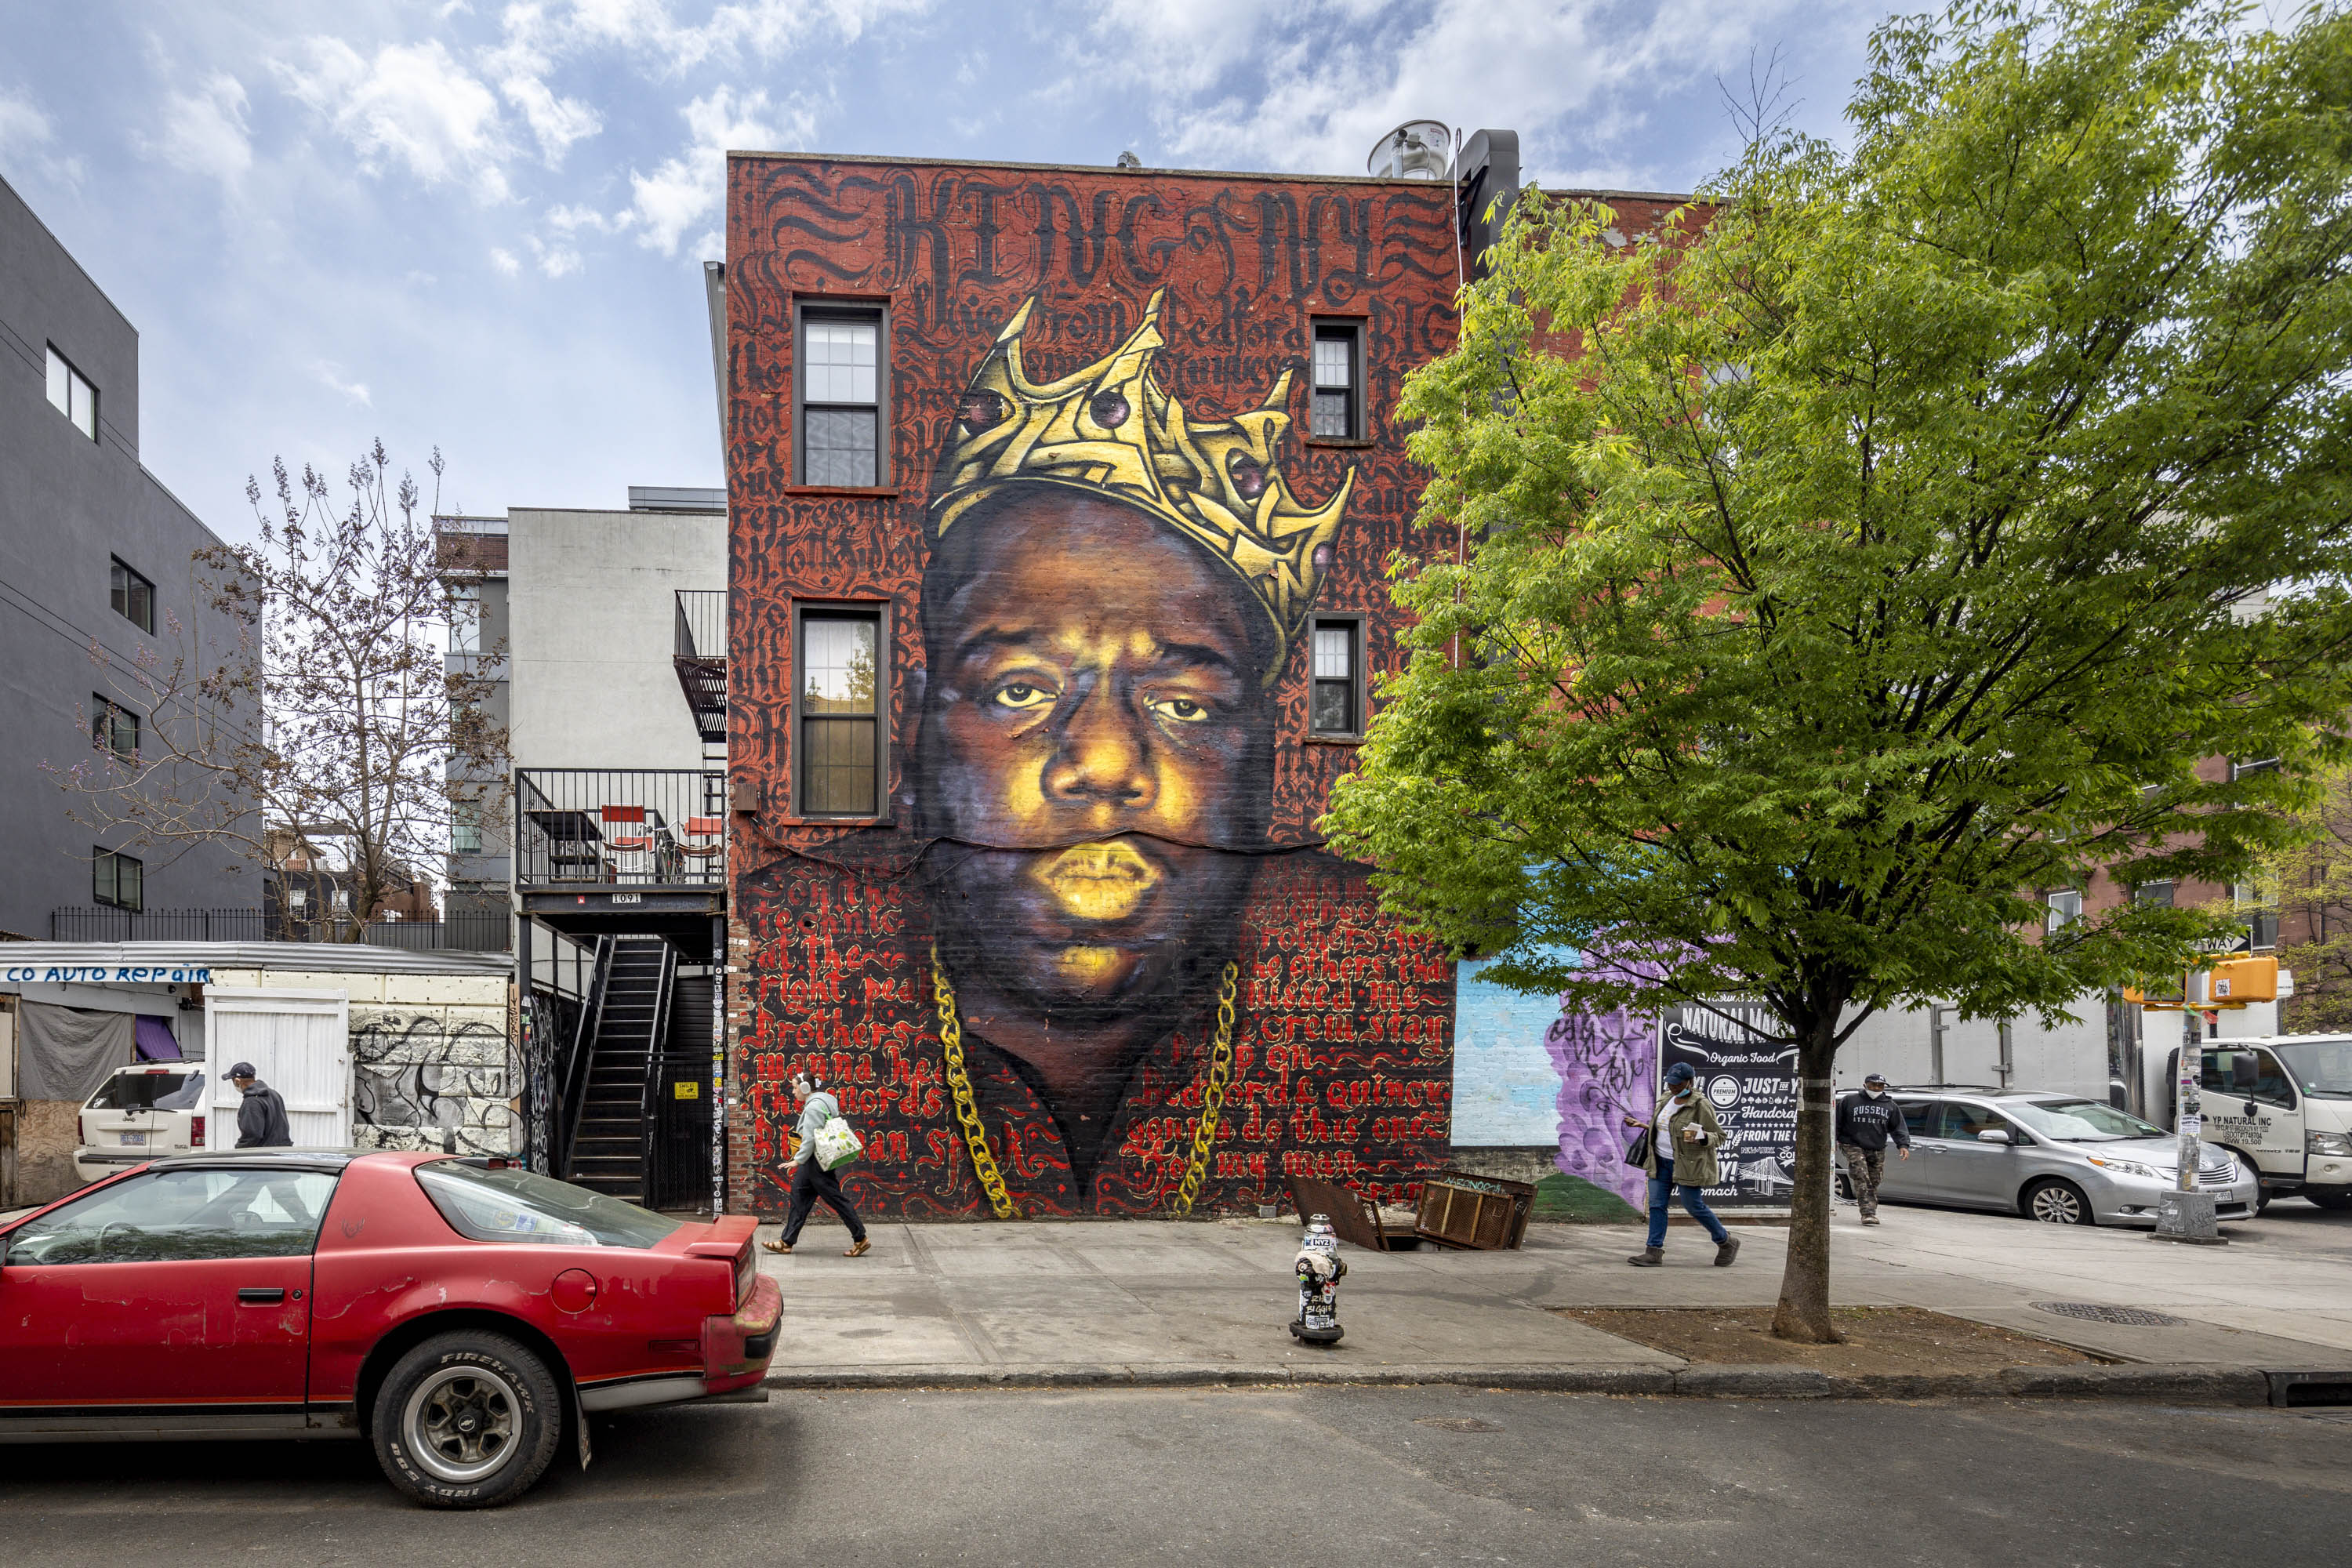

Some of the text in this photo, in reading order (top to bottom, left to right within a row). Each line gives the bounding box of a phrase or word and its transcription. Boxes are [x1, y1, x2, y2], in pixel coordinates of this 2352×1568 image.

[614, 894, 640, 902] 1091
[2207, 938, 2234, 949] WAY
[45, 967, 107, 982] AUTO
[1682, 1007, 1746, 1044] NATURAL
[1710, 1051, 1776, 1067] Organic Food
[1742, 1077, 1780, 1094] JUST
[1853, 1105, 1889, 1120] RUSSELL
[2223, 1116, 2257, 1126] NATURAL
[2259, 1117, 2272, 1127] INC
[1743, 1130, 1771, 1142] FROM
[1773, 1130, 1790, 1142] THE
[1700, 1185, 1739, 1197] omach
[441, 1352, 534, 1414] FIREHAWK
